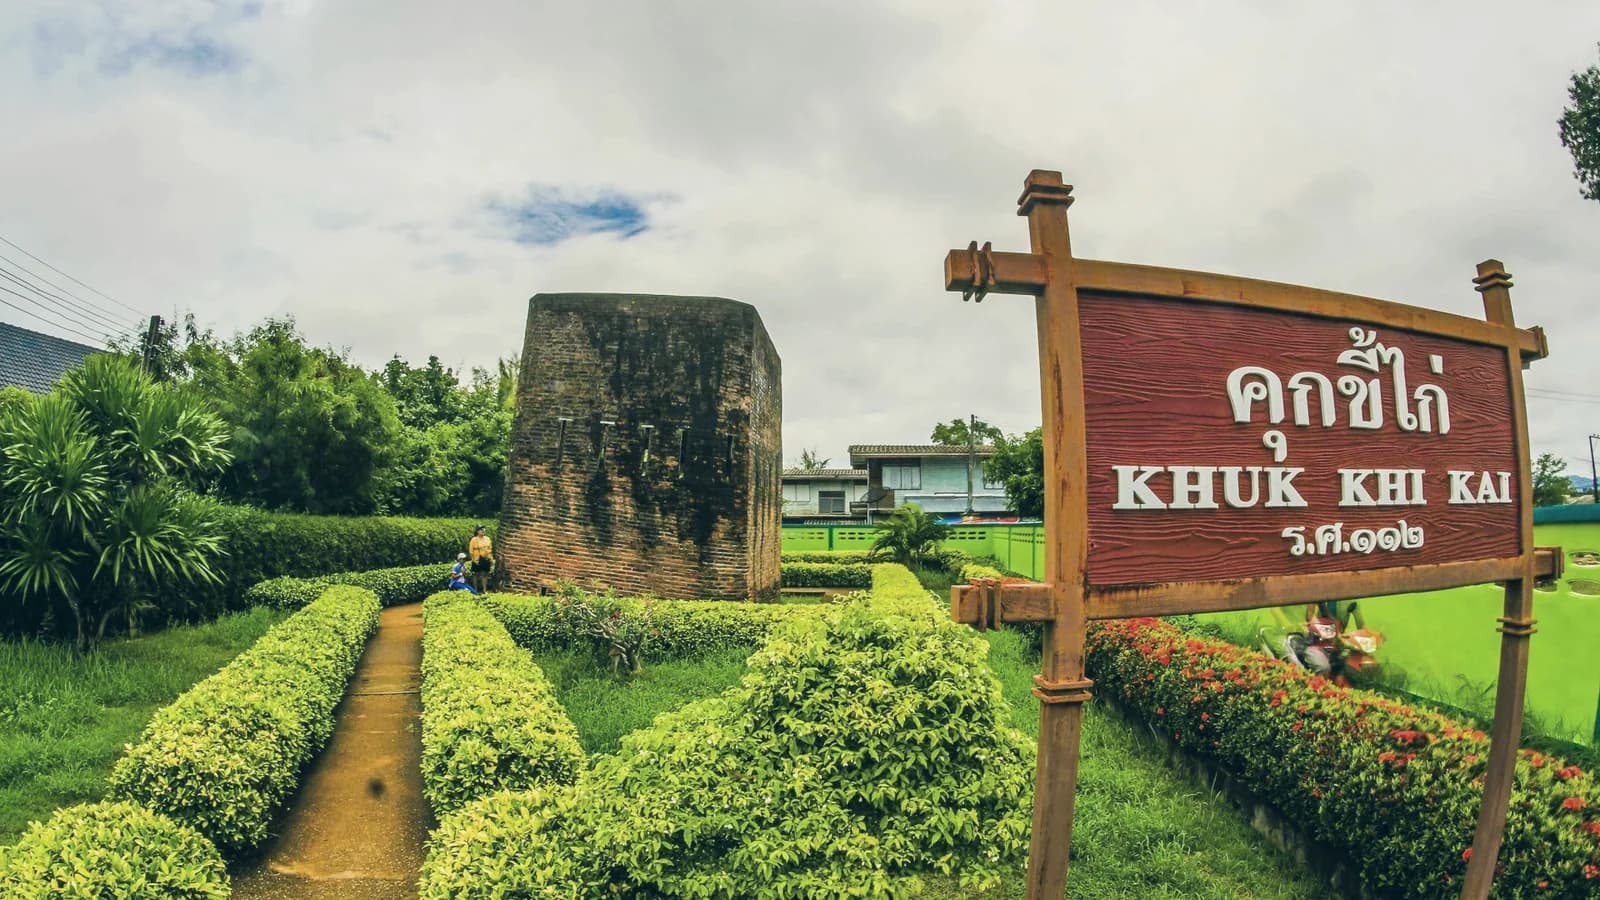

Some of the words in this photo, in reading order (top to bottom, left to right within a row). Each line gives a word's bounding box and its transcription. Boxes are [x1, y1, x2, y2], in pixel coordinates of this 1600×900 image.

[1226, 326, 1451, 463] คุกขี้ไก่
[1111, 465, 1308, 510] KHUK
[1337, 468, 1428, 507] KHI
[1447, 470, 1513, 504] KAI
[1281, 519, 1425, 556] ร.ศ.๑๑๒
